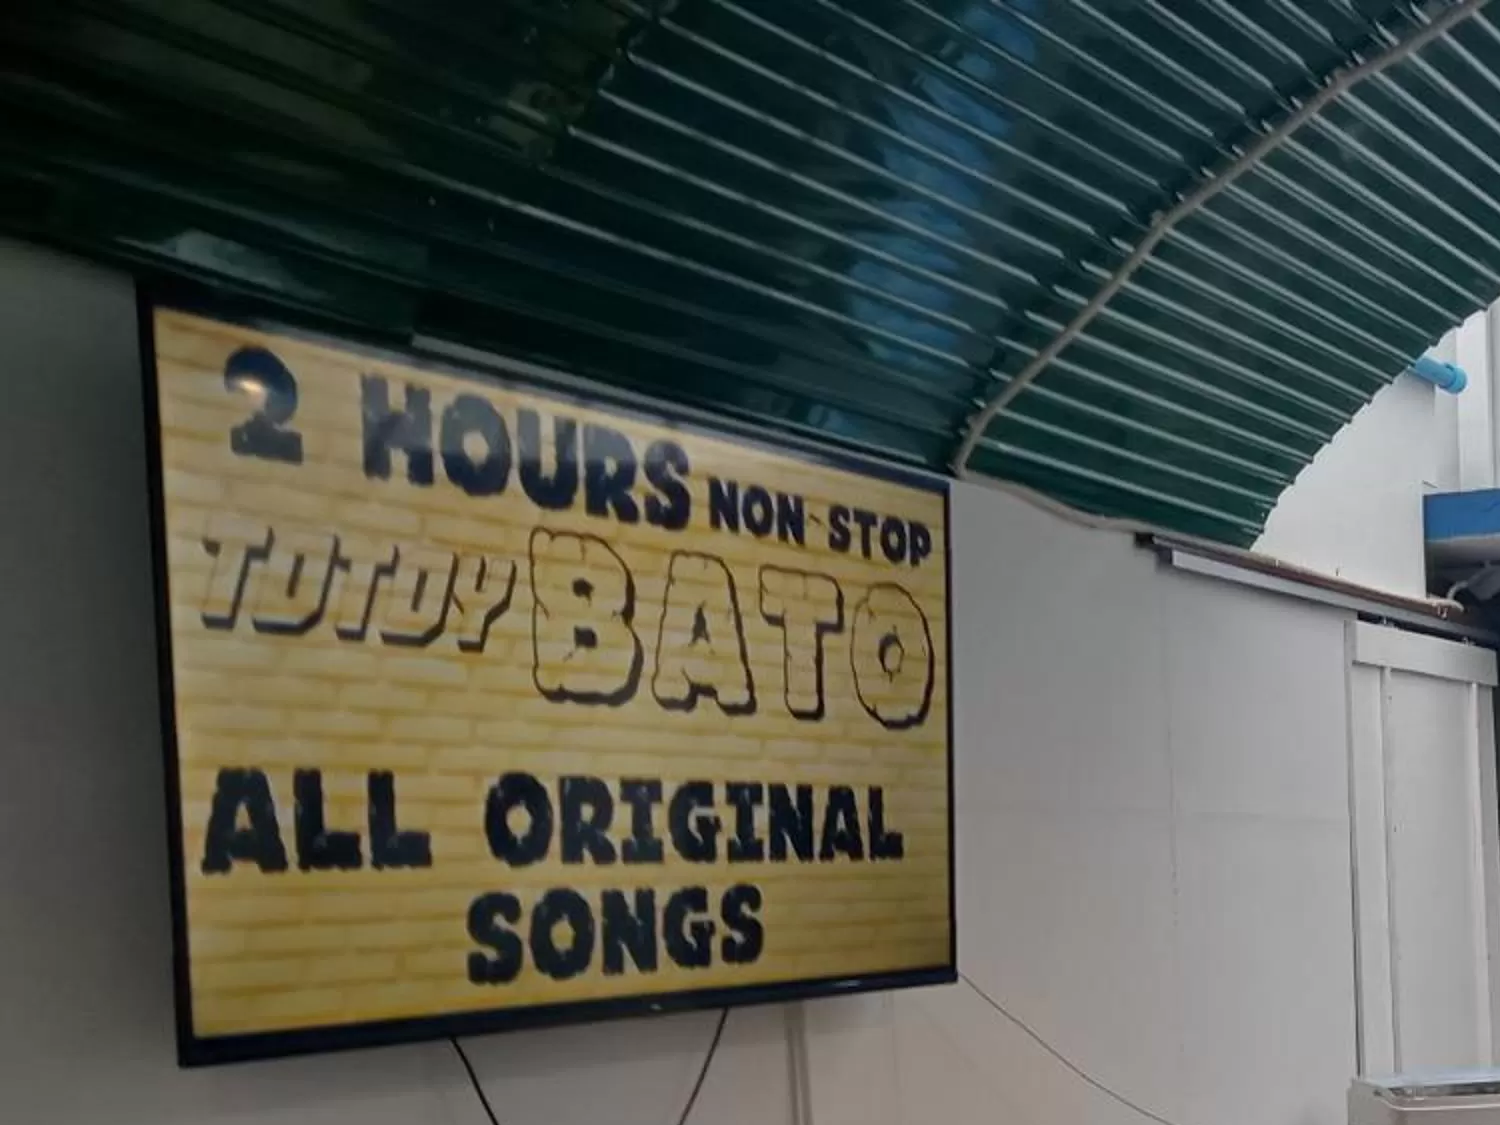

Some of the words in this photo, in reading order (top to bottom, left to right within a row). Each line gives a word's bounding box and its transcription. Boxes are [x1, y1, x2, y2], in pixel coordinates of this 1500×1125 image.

[223, 345, 304, 465] 2
[360, 373, 692, 532] HOURS
[202, 526, 516, 653] TOTOY
[528, 526, 935, 730] BATO
[201, 768, 432, 873] ALL
[484, 771, 904, 868] ORIGINAL
[467, 884, 764, 985] SONGS
